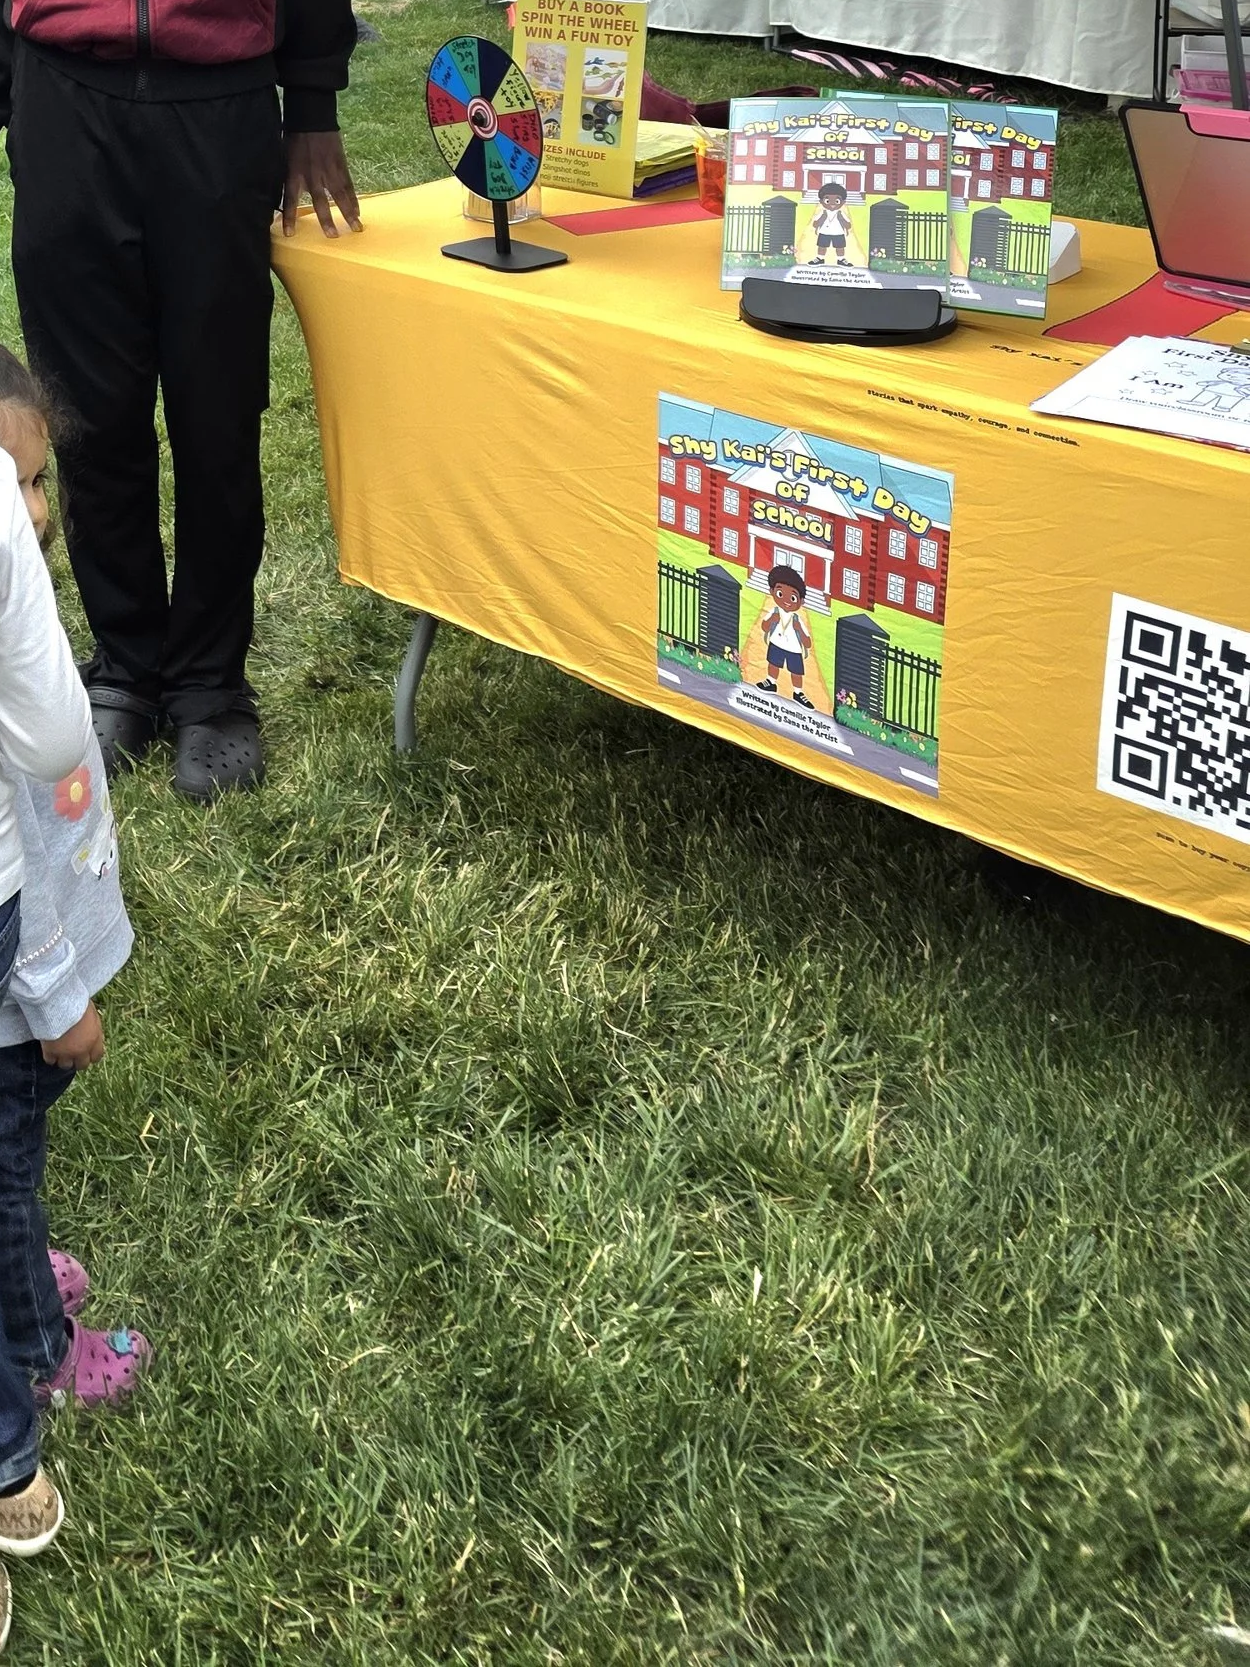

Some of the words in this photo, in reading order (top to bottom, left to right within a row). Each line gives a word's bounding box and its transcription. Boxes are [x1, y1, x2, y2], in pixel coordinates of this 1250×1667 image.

[569, 1, 579, 12] A
[584, 3, 625, 16] BOOK
[521, 11, 553, 24] SPIN
[558, 14, 585, 27] THE
[590, 17, 639, 32] WHEEL
[525, 26, 552, 39] WIN
[557, 29, 566, 40] A
[571, 30, 599, 44] FUN
[604, 33, 633, 47] TOY
[743, 121, 779, 136] Shy
[784, 114, 830, 127] Kai's
[837, 114, 890, 131] First
[894, 122, 935, 142] Day
[1002, 126, 1042, 150] Day
[543, 145, 563, 154] IZES
[566, 148, 607, 161] INCLUDE
[546, 155, 572, 165] Stretchy
[574, 158, 589, 167] dogs
[543, 164, 571, 174] Slingshot
[574, 168, 591, 177] dinos
[577, 178, 599, 188] figures
[1162, 348, 1214, 361] First
[1219, 358, 1250, 367] Da
[1148, 379, 1184, 389] Am
[898, 397, 914, 406] that
[917, 402, 938, 412] spark
[941, 409, 974, 422] empathy,
[978, 417, 1011, 431] courage,
[1016, 426, 1029, 434] and
[1033, 430, 1080, 447] connection.
[668, 434, 717, 462] Shy
[722, 439, 787, 469] Kai's
[793, 454, 868, 499] First
[873, 487, 931, 535] Day
[736, 697, 772, 717] Illustrated
[773, 712, 782, 723] by
[783, 716, 801, 729] Sana
[802, 723, 814, 734] the
[815, 729, 838, 744] Artist
[742, 690, 770, 707] Written
[771, 702, 780, 713] by
[780, 706, 807, 722] Camille
[808, 716, 831, 731] Taylor
